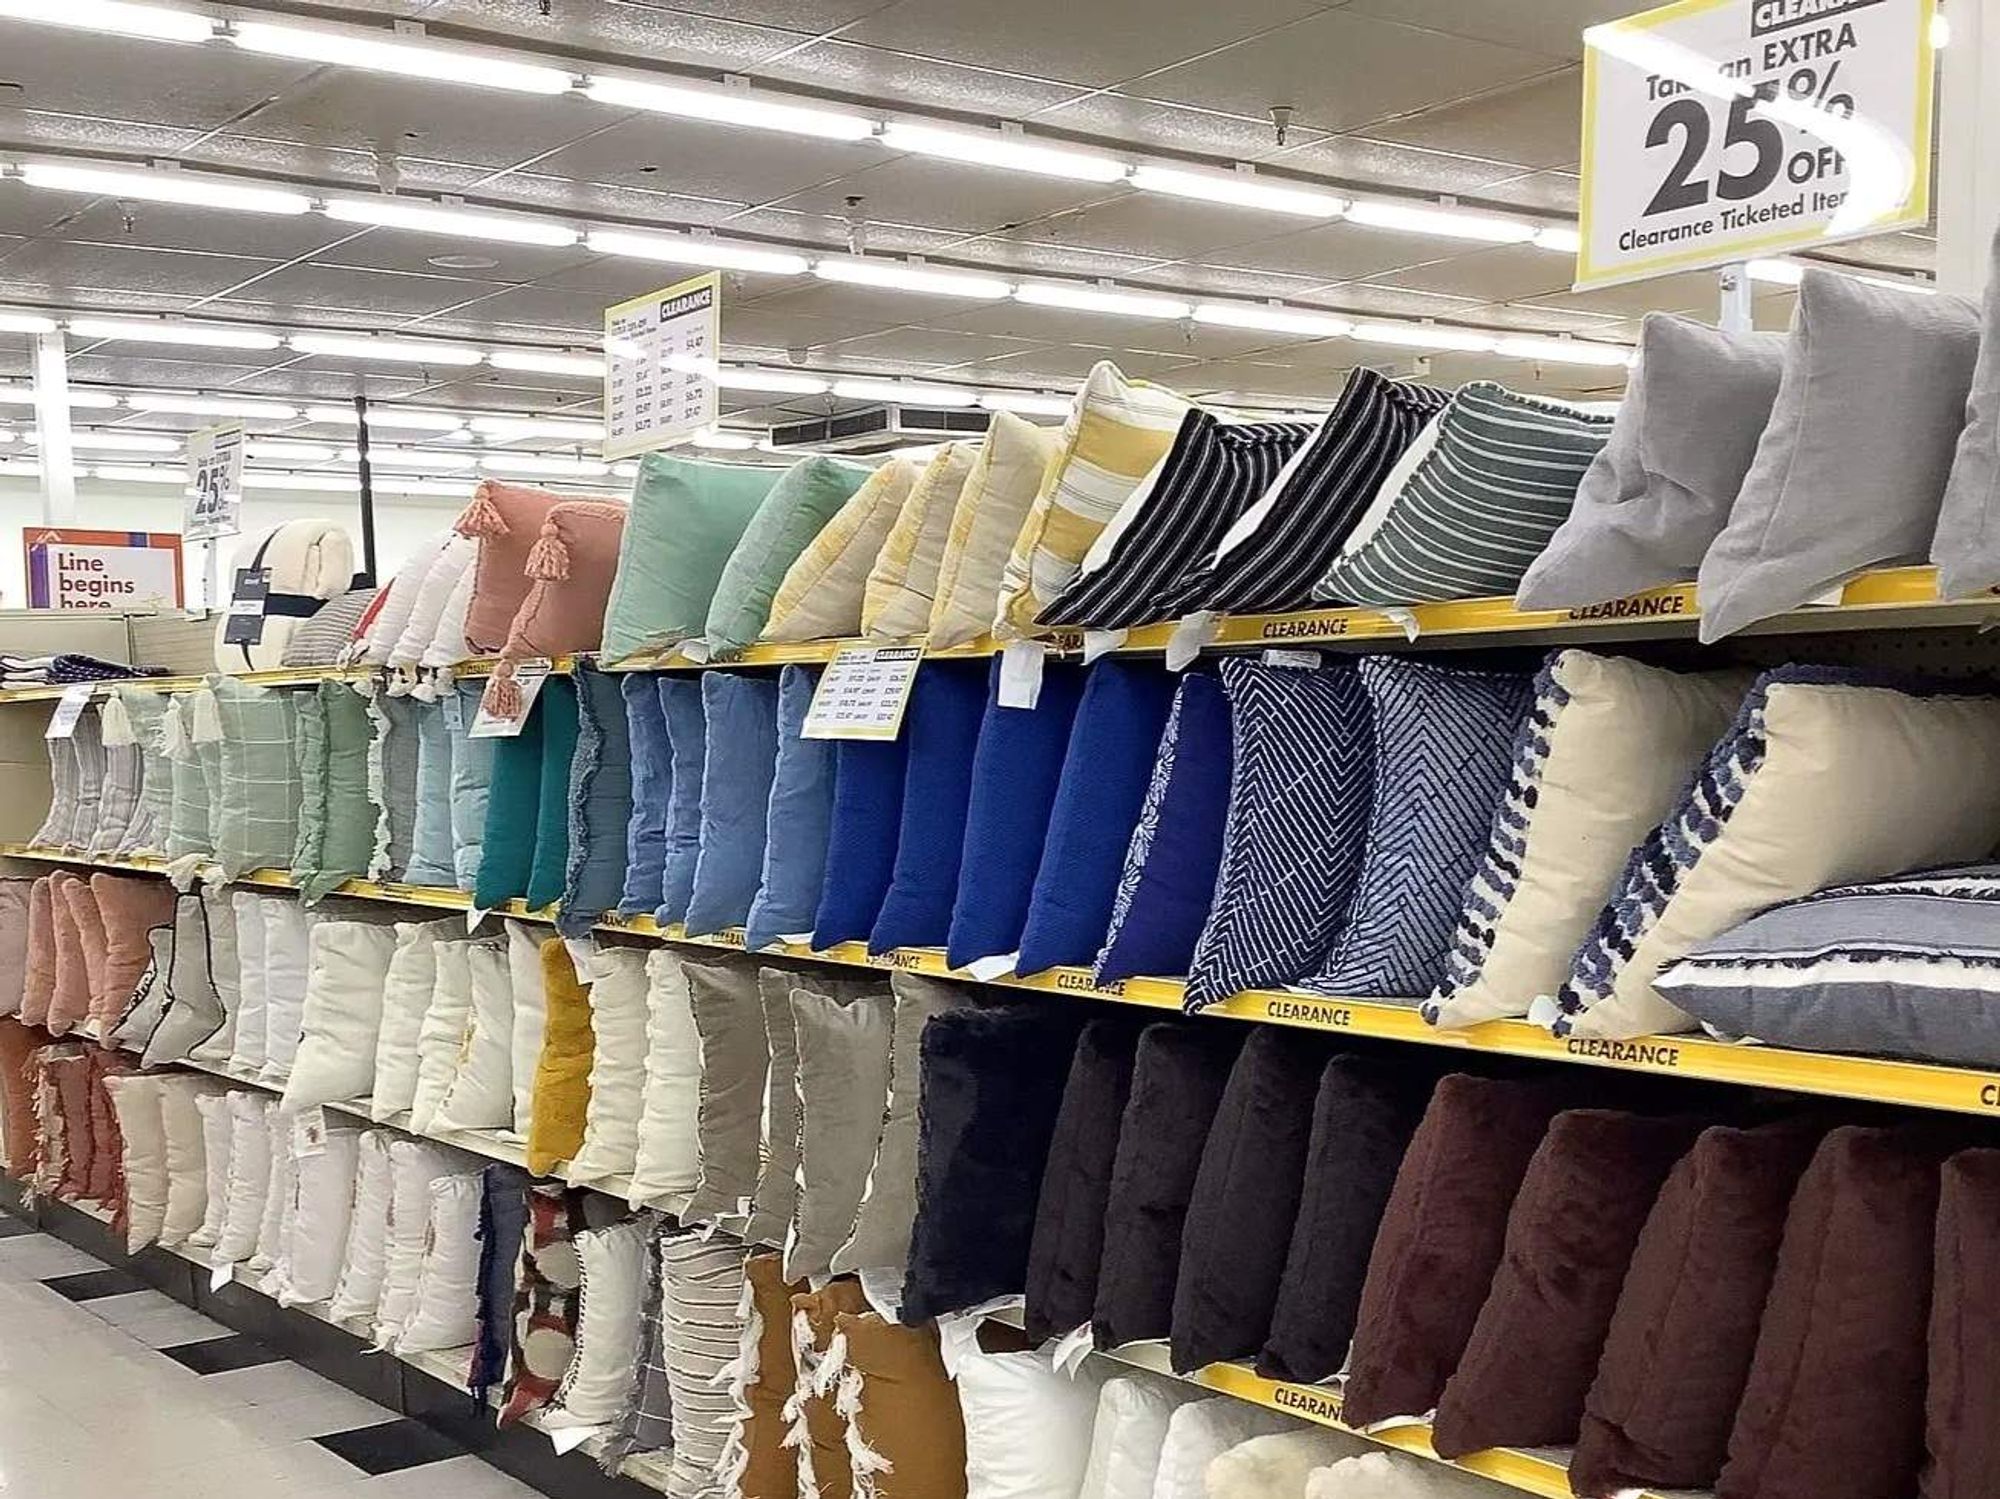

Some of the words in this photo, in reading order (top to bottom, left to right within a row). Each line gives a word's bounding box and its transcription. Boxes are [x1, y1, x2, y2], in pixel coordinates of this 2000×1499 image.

[1764, 22, 1857, 70] EXTRA
[1619, 219, 1714, 251] Clearance
[1720, 193, 1804, 231] Ticketed
[661, 289, 711, 318] CLEARANCE
[58, 552, 104, 571] Line
[59, 573, 135, 597] begins
[1568, 596, 1684, 619] CLEARANCE
[1263, 618, 1348, 638] CLEARANCE
[1268, 1001, 1351, 1026] CLEARANCE
[1567, 1039, 1679, 1066] CLEARANCE
[1274, 1387, 1341, 1420] CLEARAN
